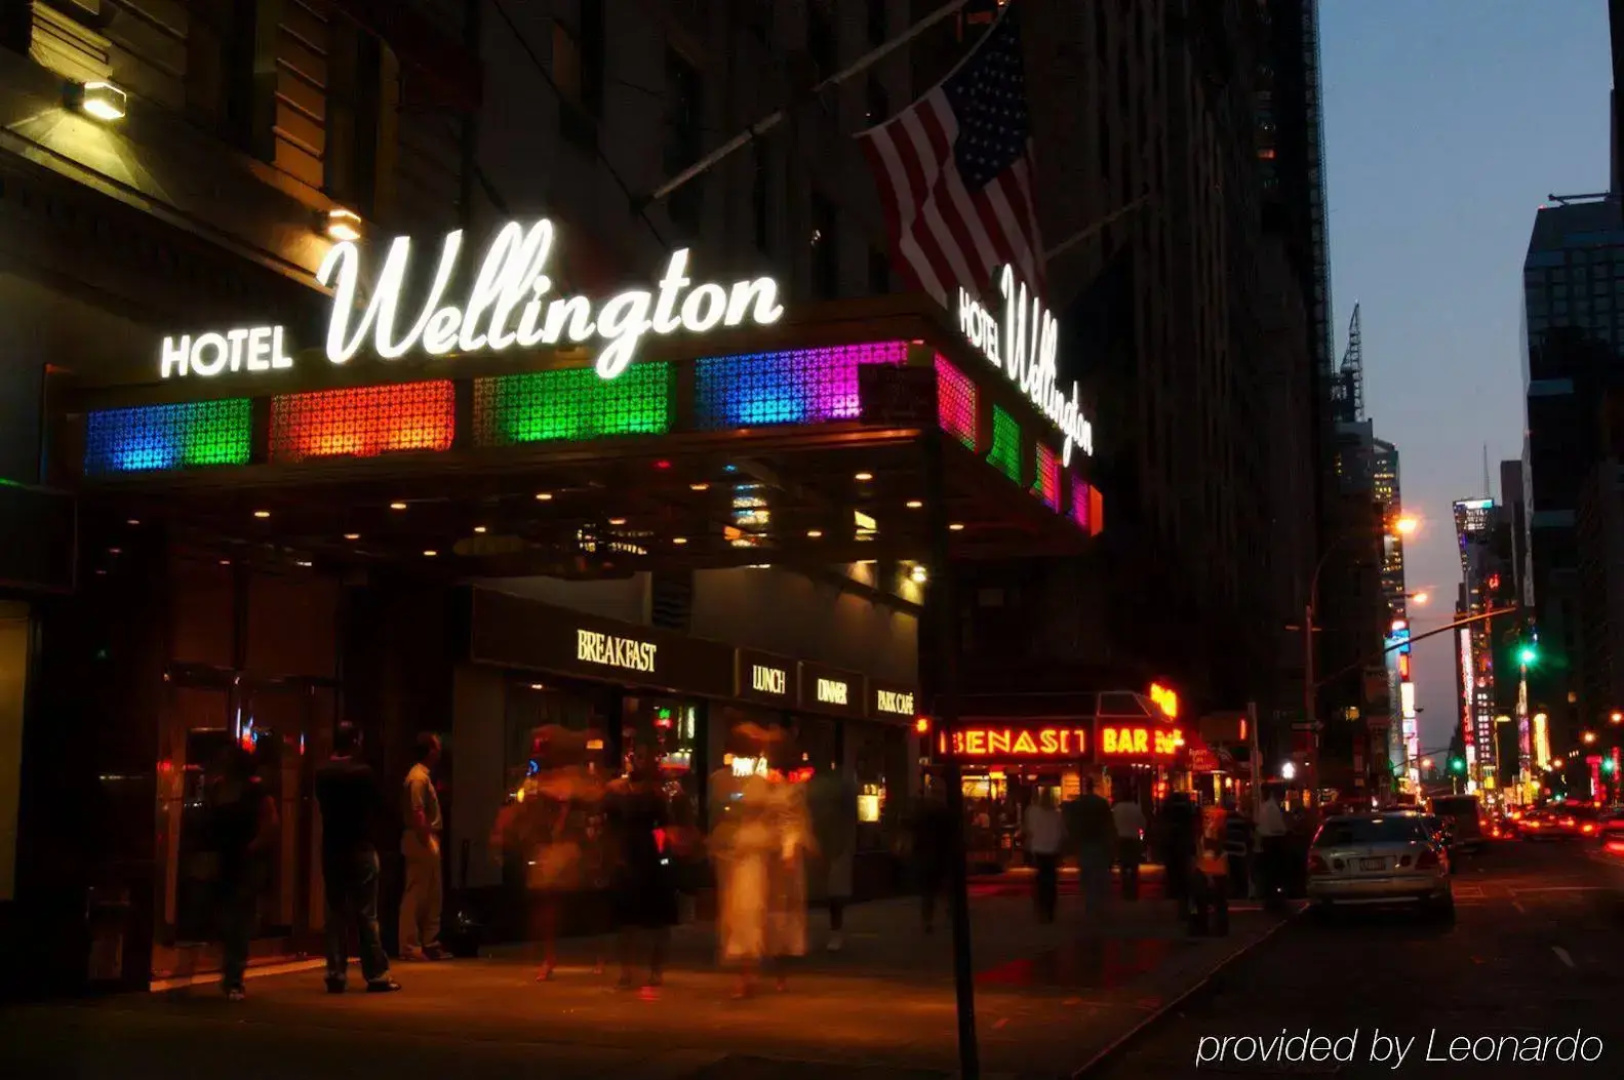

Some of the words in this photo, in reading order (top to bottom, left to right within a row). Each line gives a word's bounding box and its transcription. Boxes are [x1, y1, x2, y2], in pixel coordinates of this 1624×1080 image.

[160, 325, 294, 379] HOTEL
[316, 217, 785, 379] Wellington
[958, 286, 1002, 369] HOTEL
[1001, 263, 1094, 468] Wellington
[577, 629, 656, 673] BREAKFAST
[752, 665, 786, 694] LUNCH
[817, 678, 848, 705] DINNER
[877, 690, 898, 713] PARK
[1103, 727, 1148, 754] BAR
